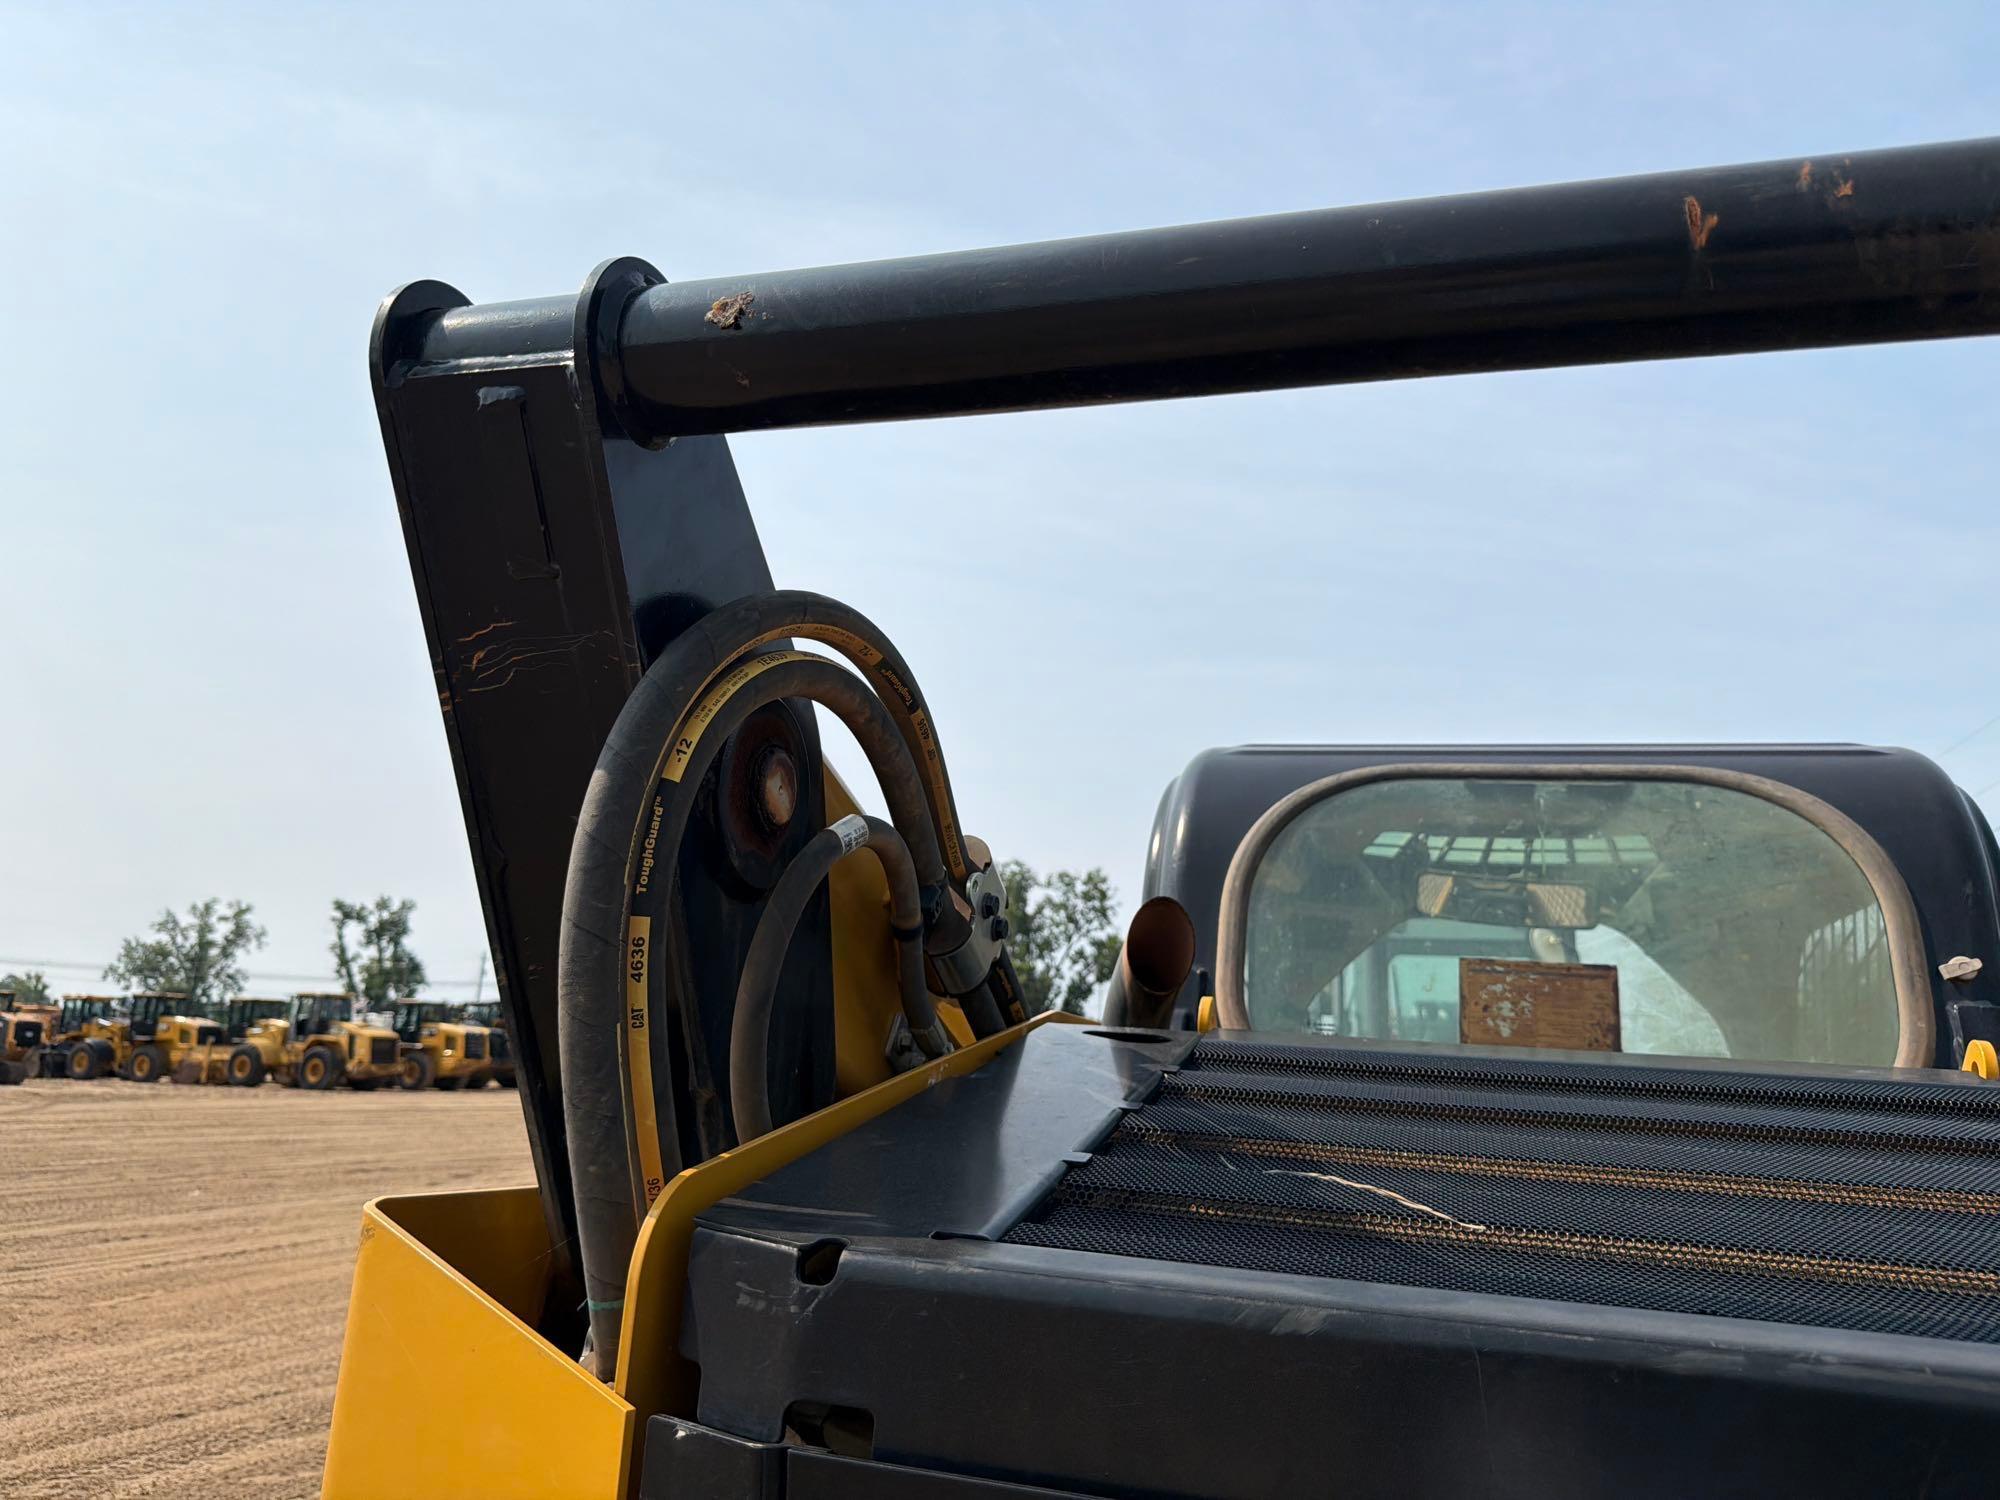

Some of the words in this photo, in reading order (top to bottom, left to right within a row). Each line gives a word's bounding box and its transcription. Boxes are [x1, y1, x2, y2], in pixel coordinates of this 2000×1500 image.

[917, 718, 930, 740] 4636
[675, 738, 693, 763] -12
[630, 936, 646, 983] 4636
[630, 1004, 645, 1029] CAT
